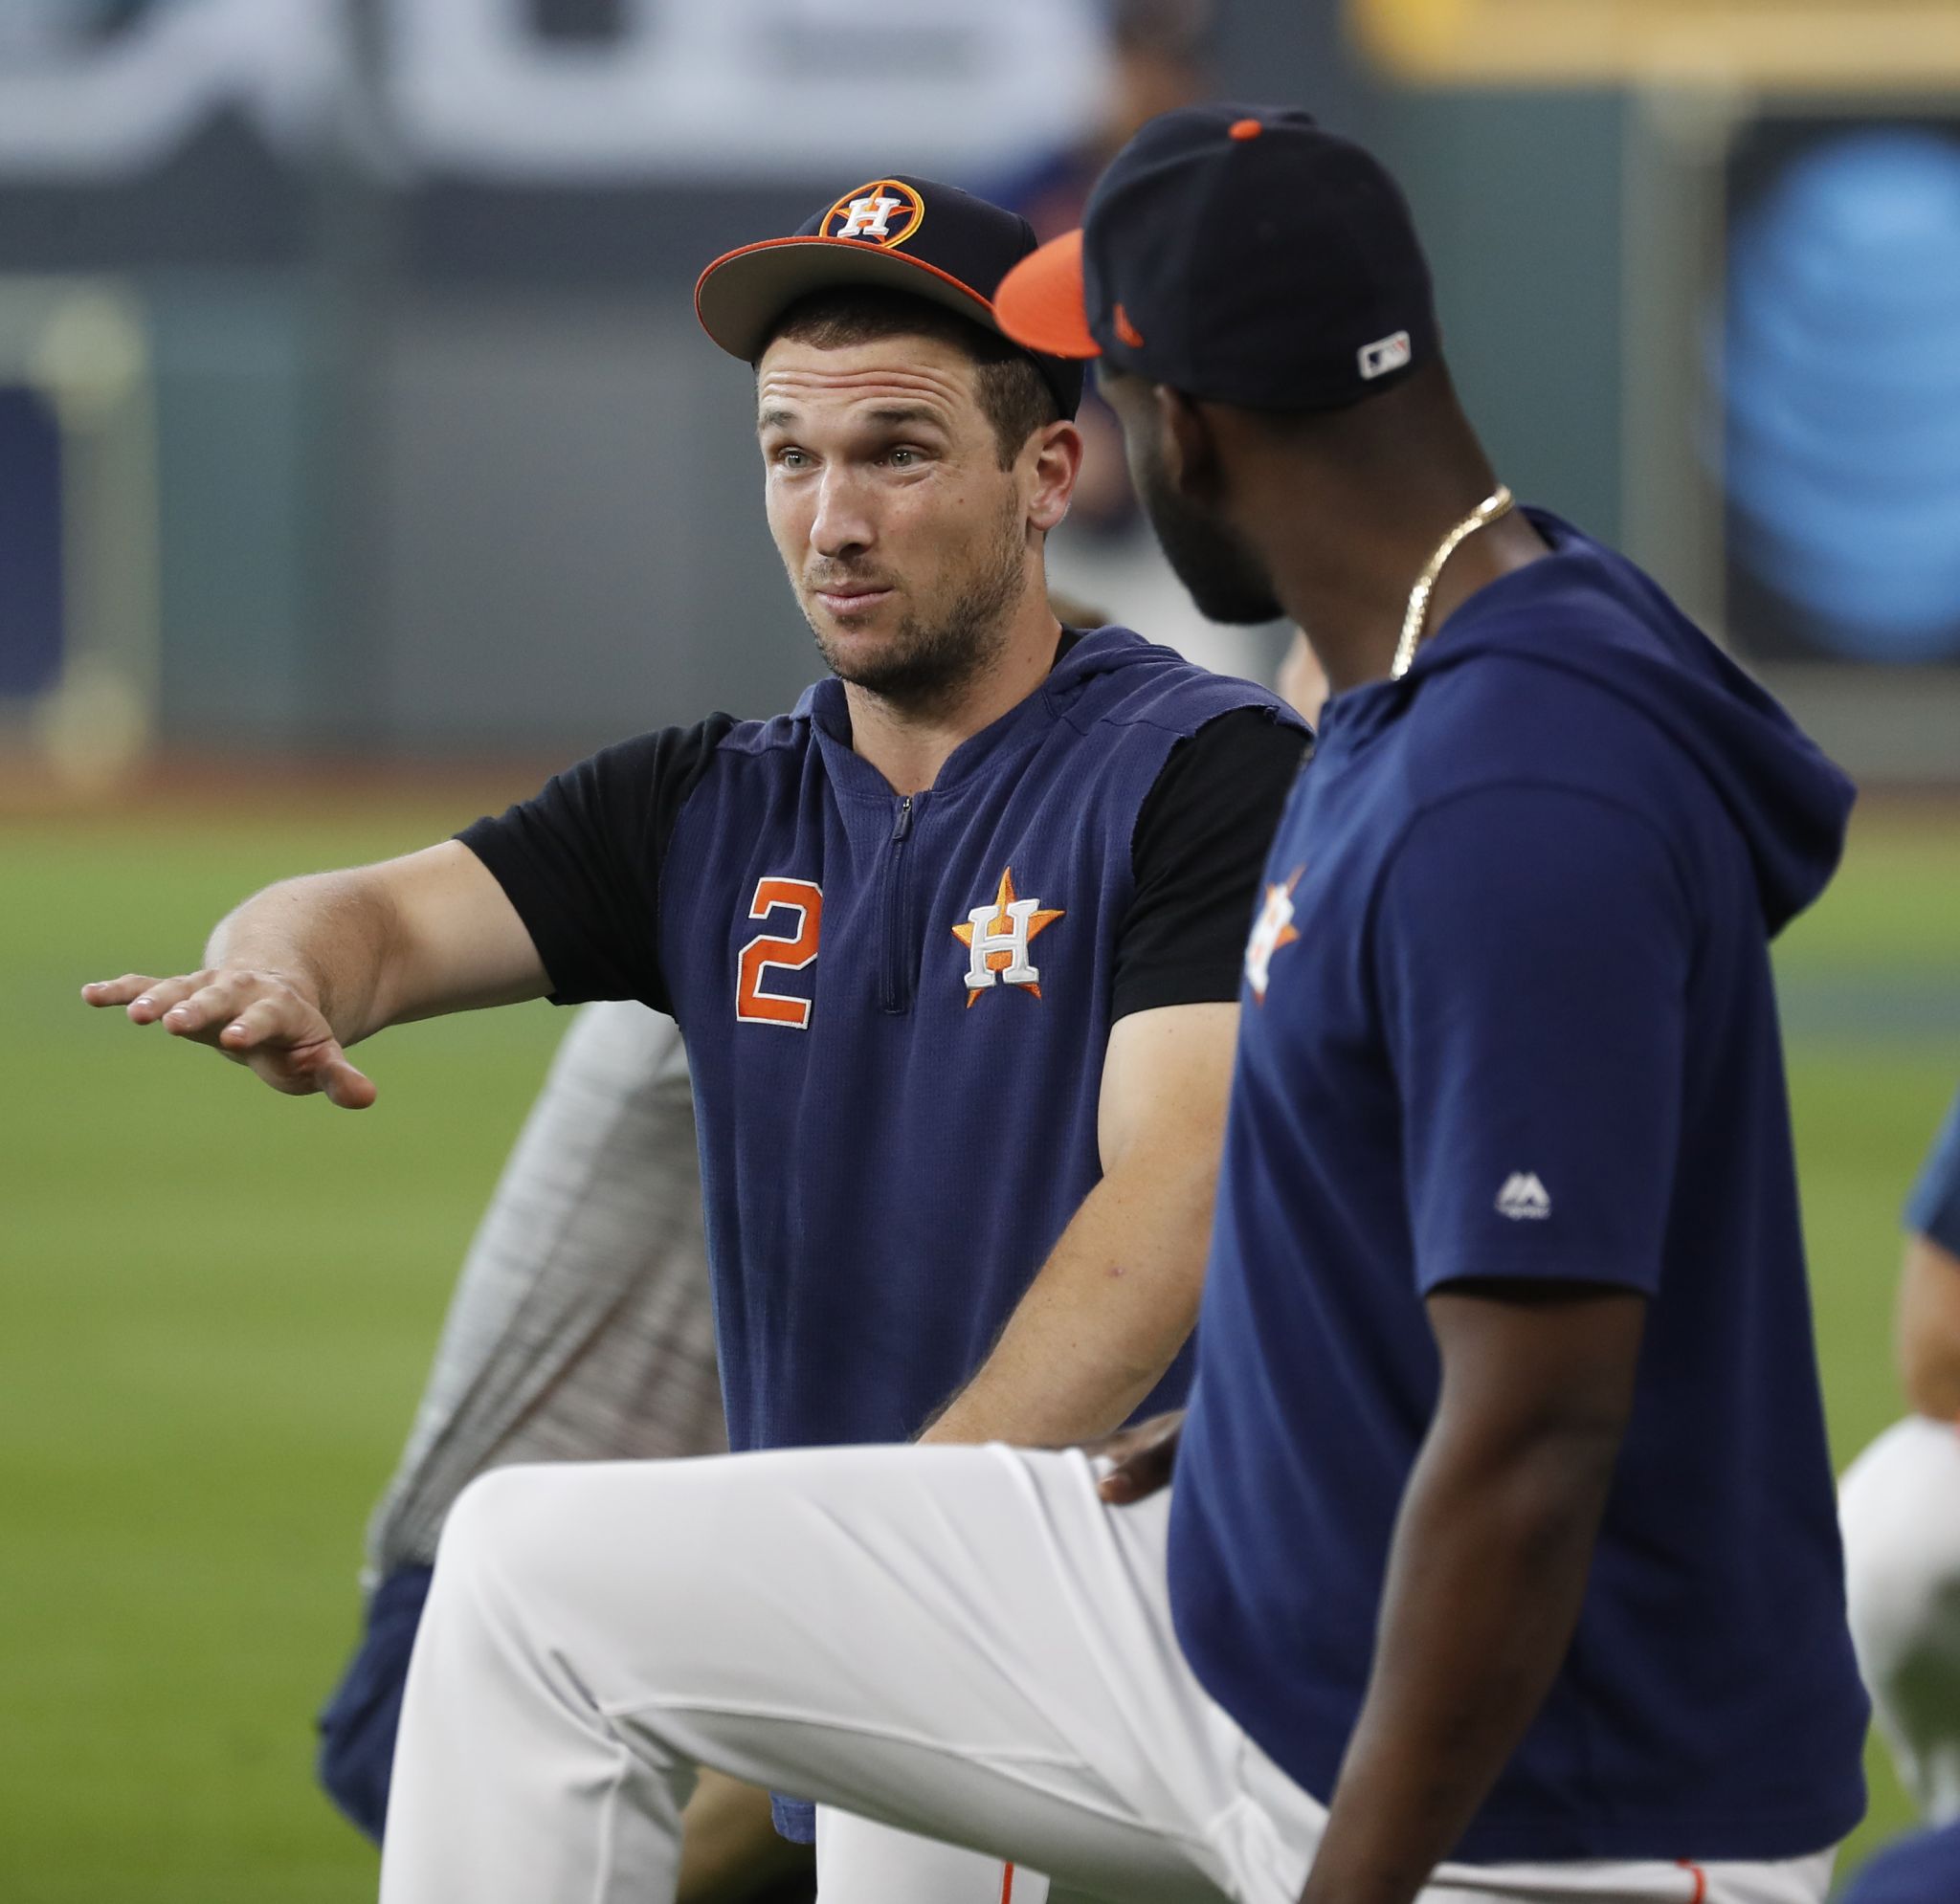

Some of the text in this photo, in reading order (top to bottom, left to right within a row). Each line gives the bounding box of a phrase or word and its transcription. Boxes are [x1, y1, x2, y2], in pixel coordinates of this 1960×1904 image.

[837, 197, 901, 237] H
[736, 876, 823, 1029] 2
[964, 897, 1040, 988] H
